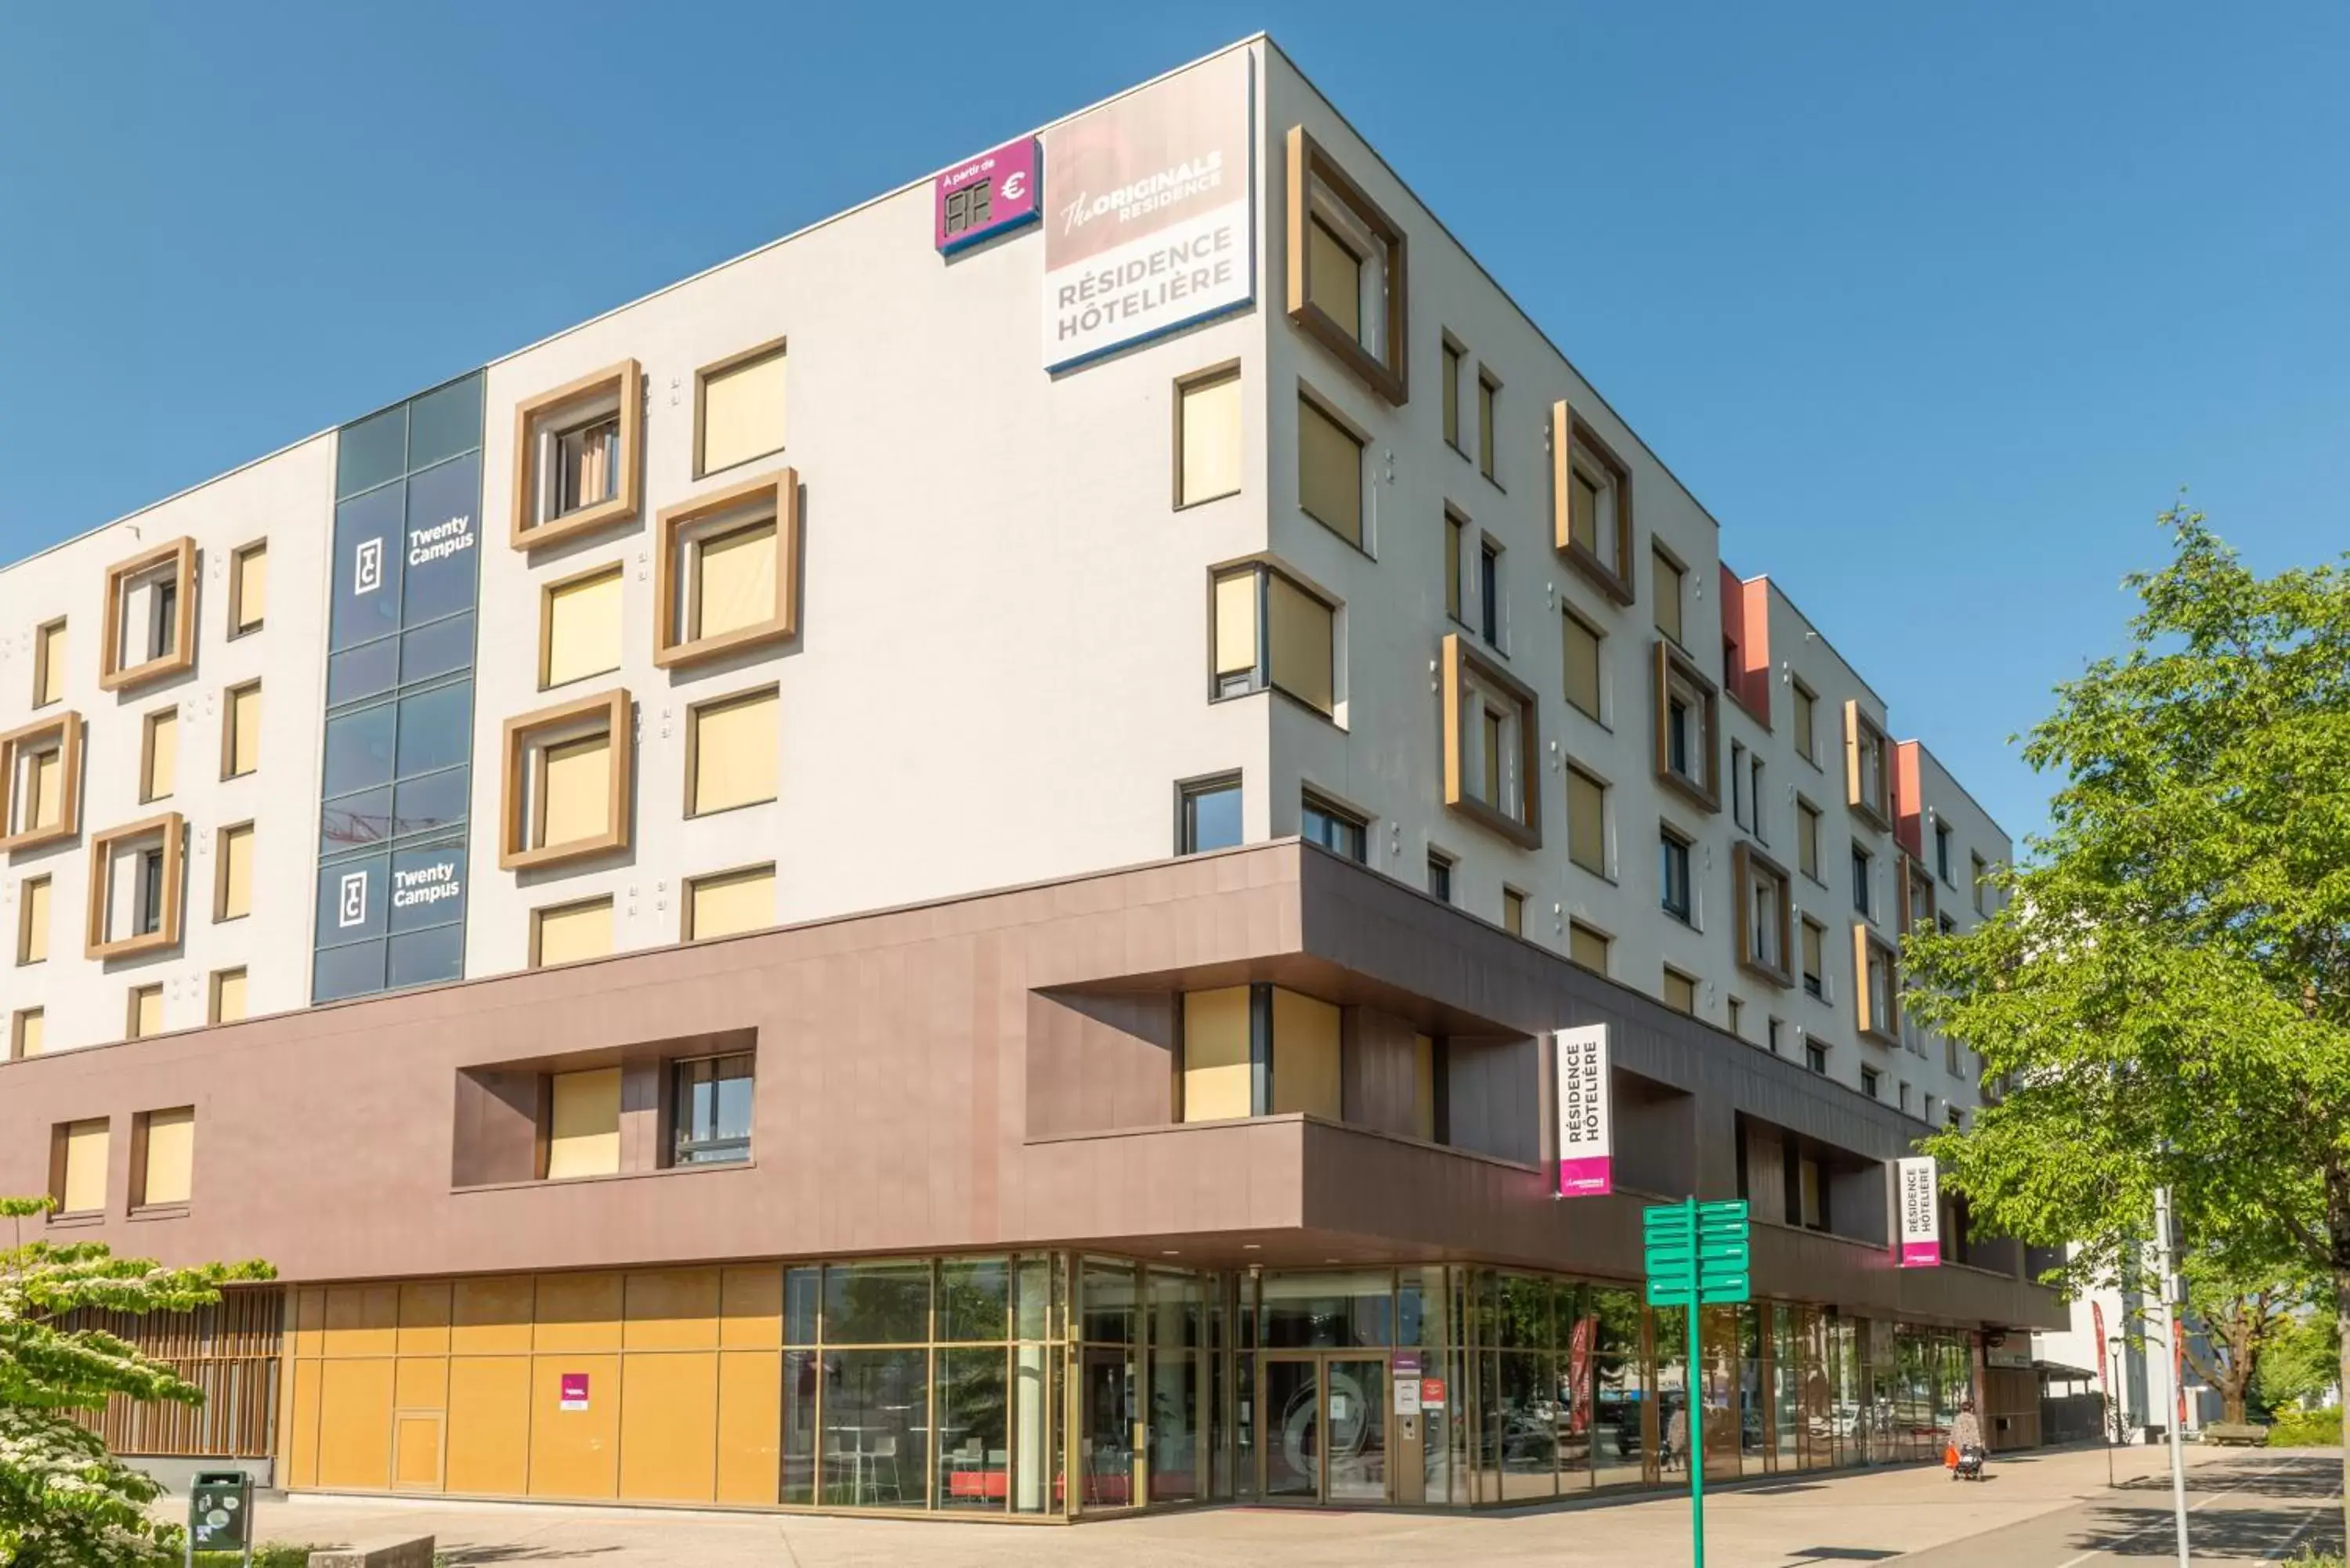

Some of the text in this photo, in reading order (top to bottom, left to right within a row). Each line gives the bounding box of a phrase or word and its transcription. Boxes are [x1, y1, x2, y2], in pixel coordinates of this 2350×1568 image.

[1059, 150, 1222, 237] The ORIGINALS
[1119, 171, 1222, 224] RESIDENCE
[1058, 225, 1233, 310] RÉSIDENCE
[1058, 258, 1233, 341] HÔTELIÈRE
[409, 532, 475, 566] Campus
[410, 515, 469, 547] Twenty
[393, 881, 460, 908] Campus
[394, 862, 455, 889] Twenty
[1566, 1042, 1582, 1143] RÉSIDENCE
[1582, 1041, 1599, 1142] HÔTELIÈRE
[1906, 1168, 1918, 1234] RÉSIDENCE
